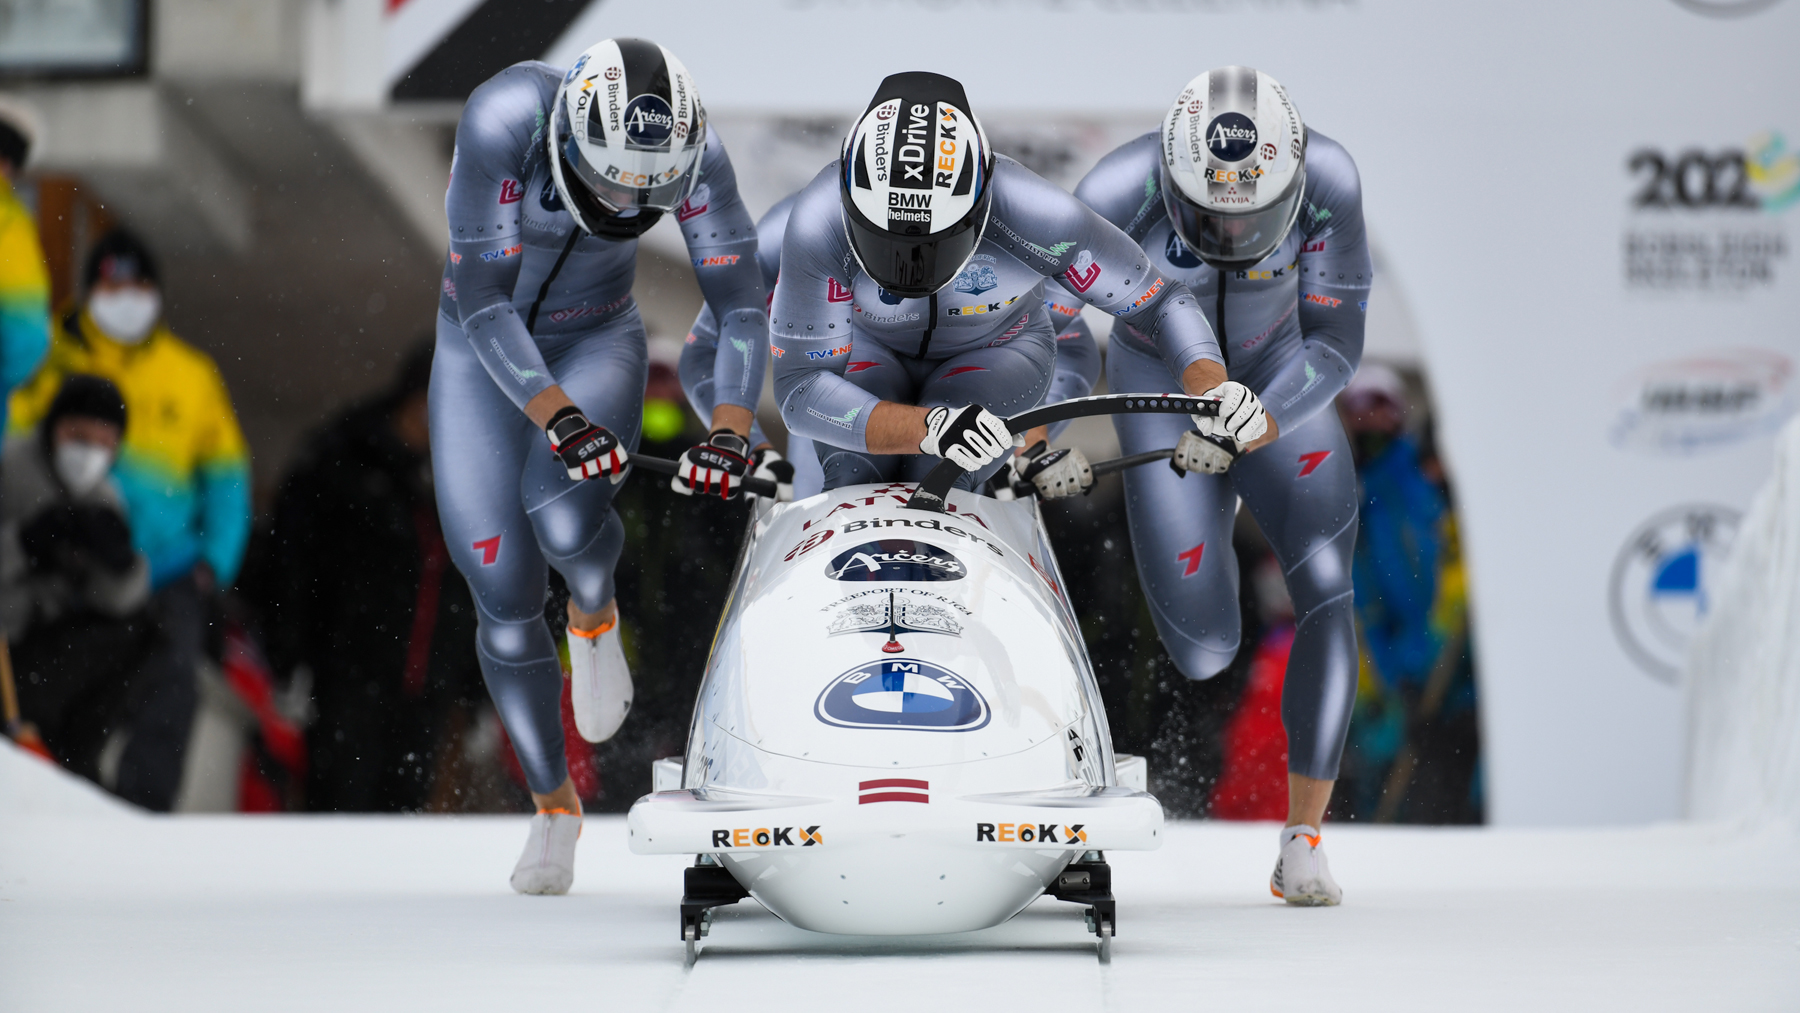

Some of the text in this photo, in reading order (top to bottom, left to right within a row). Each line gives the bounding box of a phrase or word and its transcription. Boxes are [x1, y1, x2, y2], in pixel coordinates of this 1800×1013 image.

[607, 83, 621, 132] Binders
[675, 73, 689, 119] Binders
[875, 121, 890, 183] Binders
[898, 103, 930, 182] xDrive
[1166, 107, 1183, 167] Binders
[1188, 114, 1202, 163] Binders
[888, 192, 932, 209] BMW
[888, 208, 931, 223] helmets
[1214, 195, 1250, 204] LATVIJA
[863, 311, 920, 324] Binders
[841, 518, 1005, 558] Binders
[820, 587, 974, 617] FREEPORT OF RIGA
[842, 662, 966, 691] BMW
